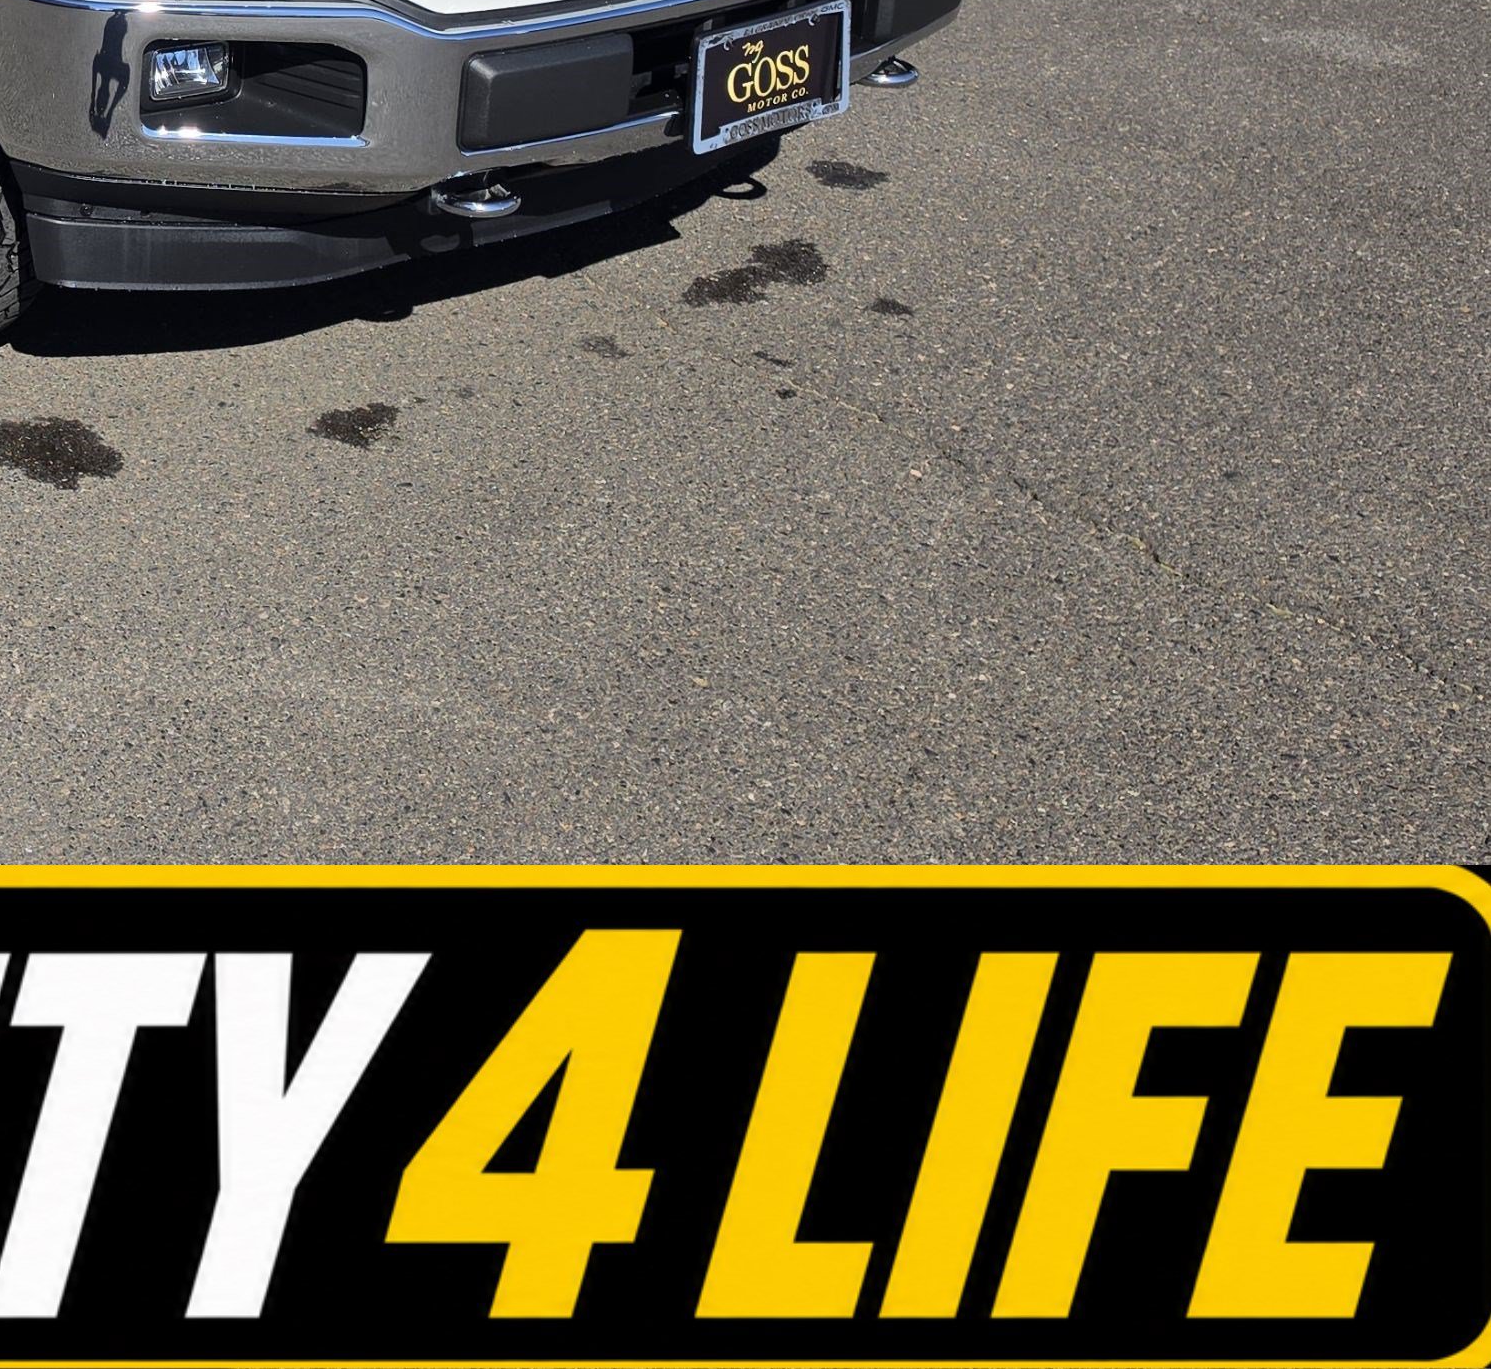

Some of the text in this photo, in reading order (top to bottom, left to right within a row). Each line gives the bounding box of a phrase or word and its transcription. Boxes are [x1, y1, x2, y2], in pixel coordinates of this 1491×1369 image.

[727, 44, 810, 103] GOSS
[747, 87, 810, 113] MOTOR CO.
